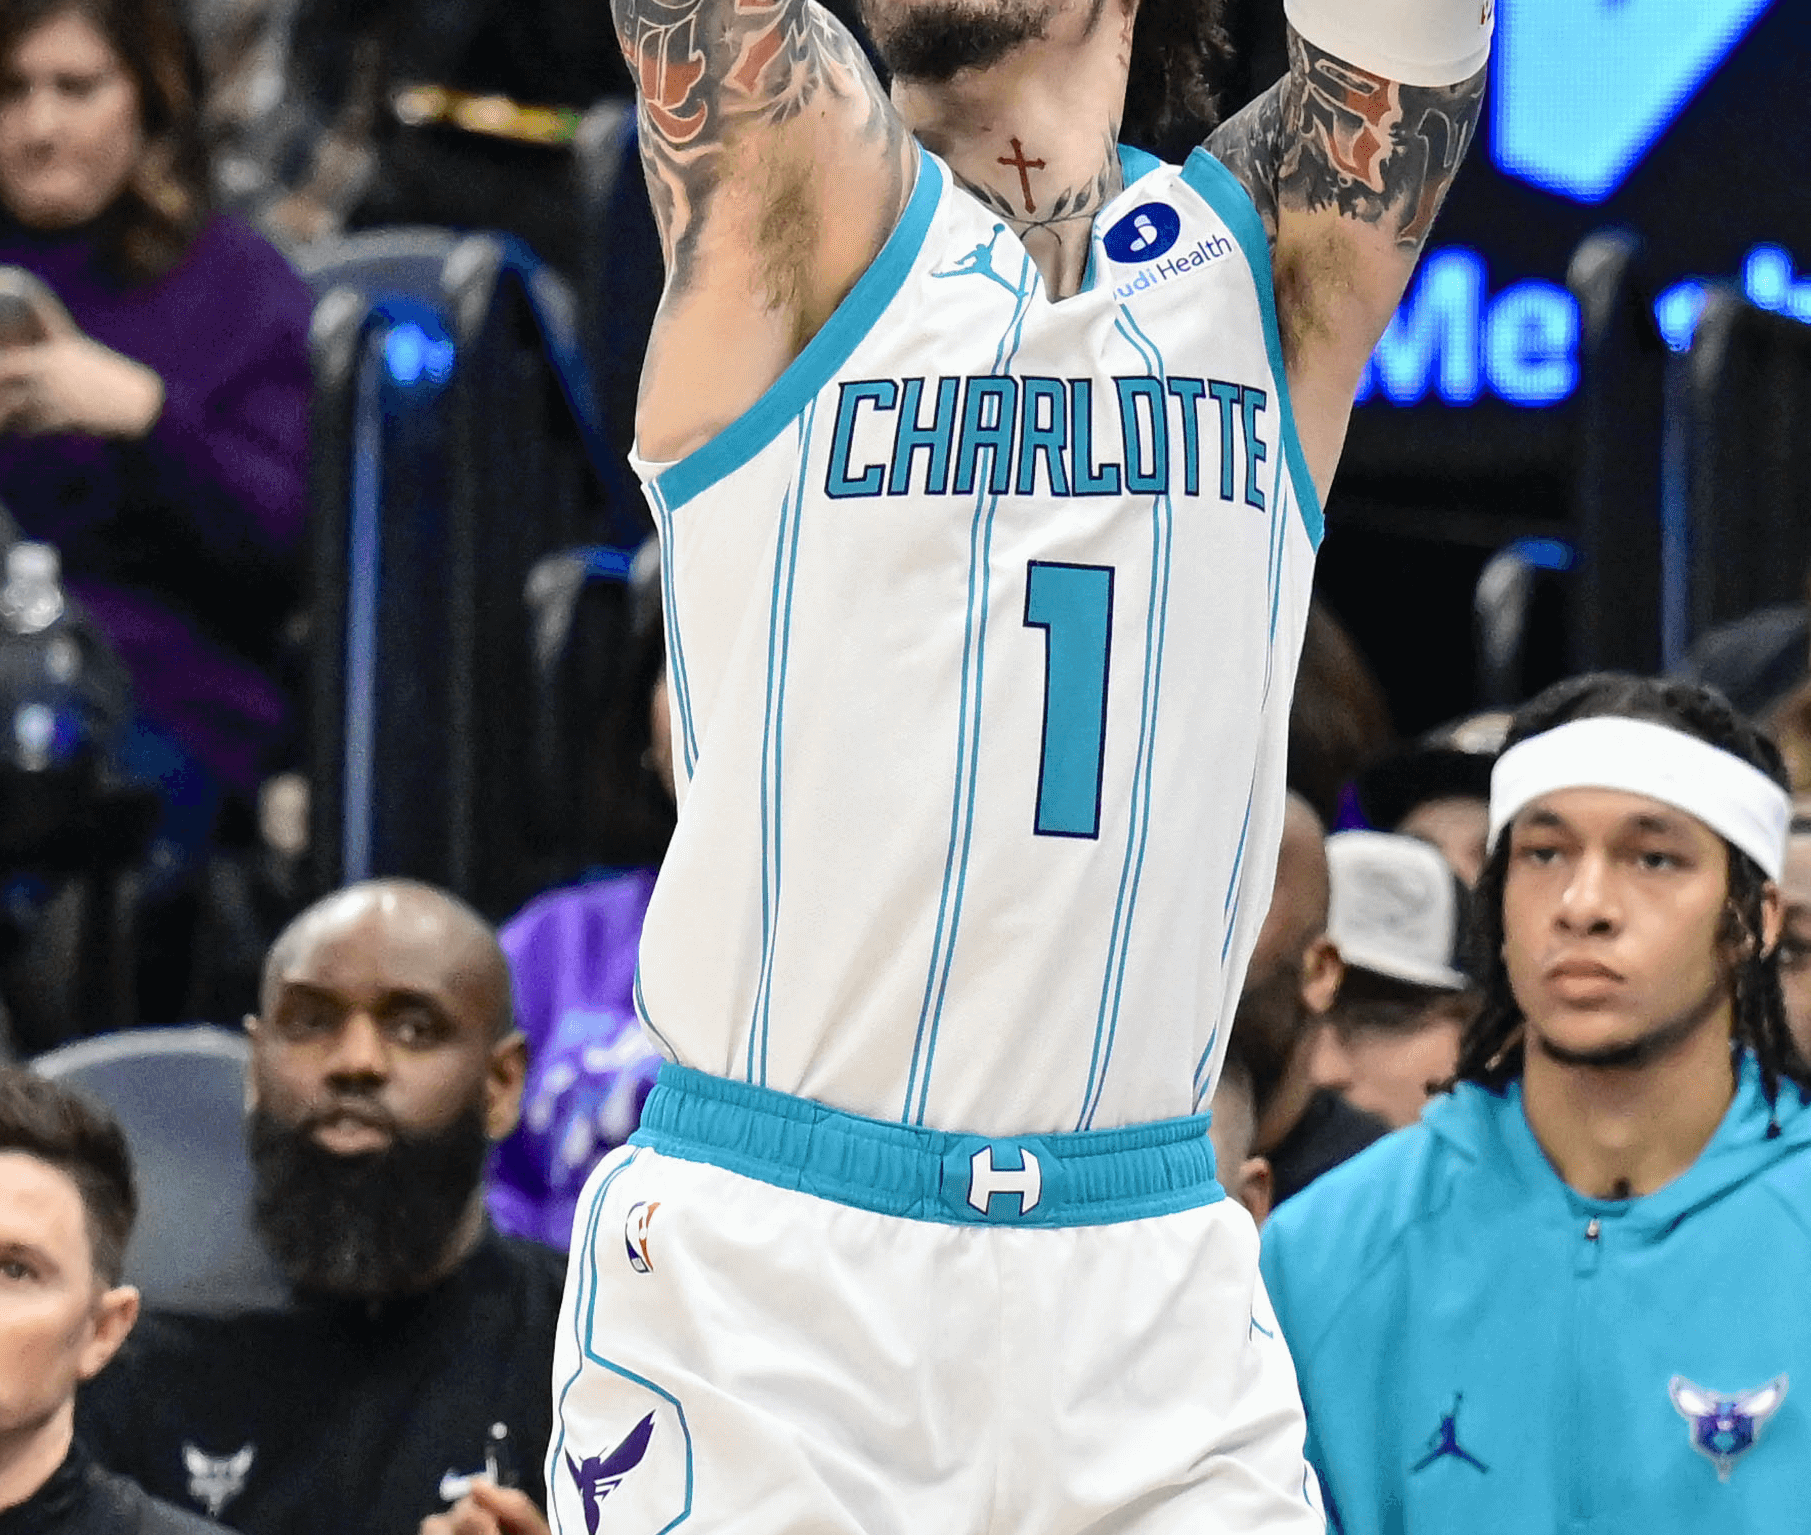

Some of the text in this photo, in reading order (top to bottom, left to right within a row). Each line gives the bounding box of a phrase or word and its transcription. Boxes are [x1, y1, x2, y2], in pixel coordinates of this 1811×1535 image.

[1113, 234, 1233, 301] udi Health
[825, 374, 1269, 514] CHARLOTTE
[1022, 560, 1116, 840] 1
